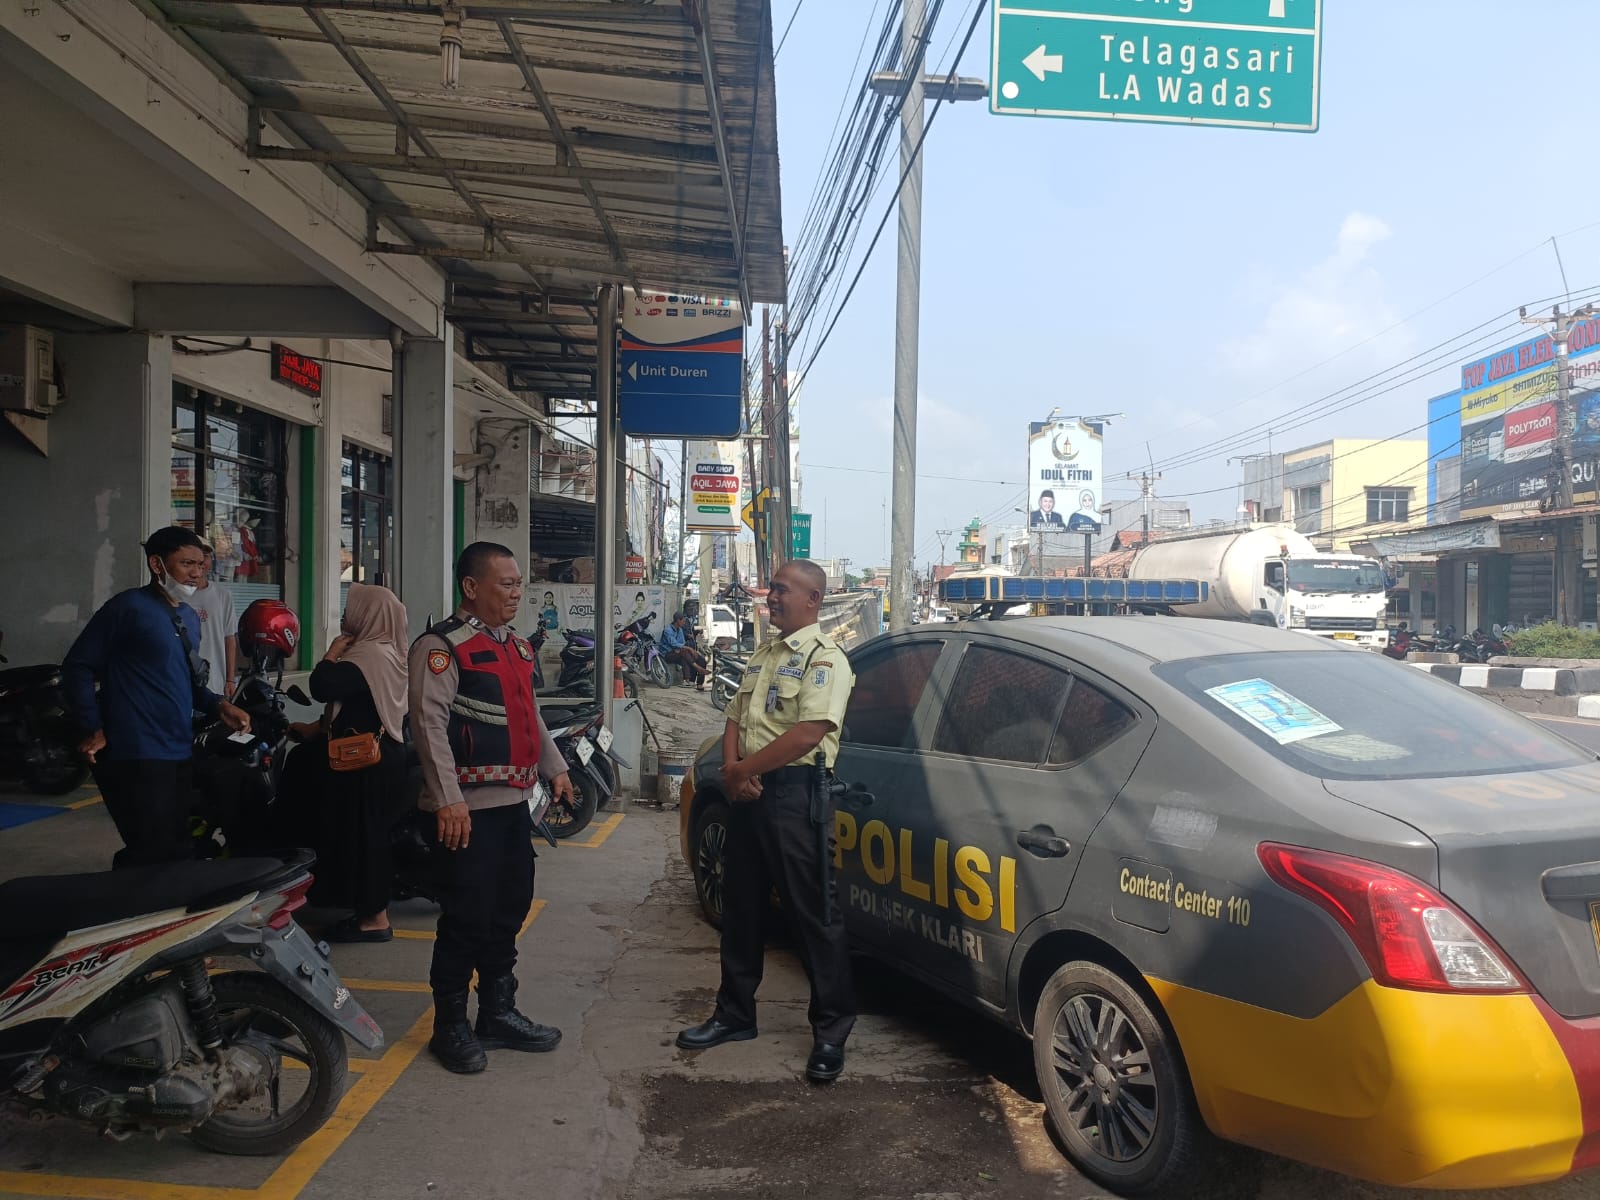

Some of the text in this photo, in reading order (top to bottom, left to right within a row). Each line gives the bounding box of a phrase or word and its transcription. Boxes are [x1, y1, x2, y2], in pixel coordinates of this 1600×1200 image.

[1100, 35, 1294, 74] Telagasari
[1099, 73, 1272, 110] L.A Wadas
[702, 308, 731, 317] BRIZZI
[640, 365, 708, 378] Unit Duren
[1463, 362, 1486, 390] TOP
[1488, 351, 1517, 382] JAYA
[697, 465, 714, 473] BABY
[1041, 469, 1093, 481] IDUL FITRI
[693, 479, 737, 489] AQIL JAYA
[569, 604, 595, 617] AQIL
[831, 809, 1017, 934] POLISI
[1119, 867, 1251, 927] Contact Center 110
[920, 912, 985, 964] KLARI
